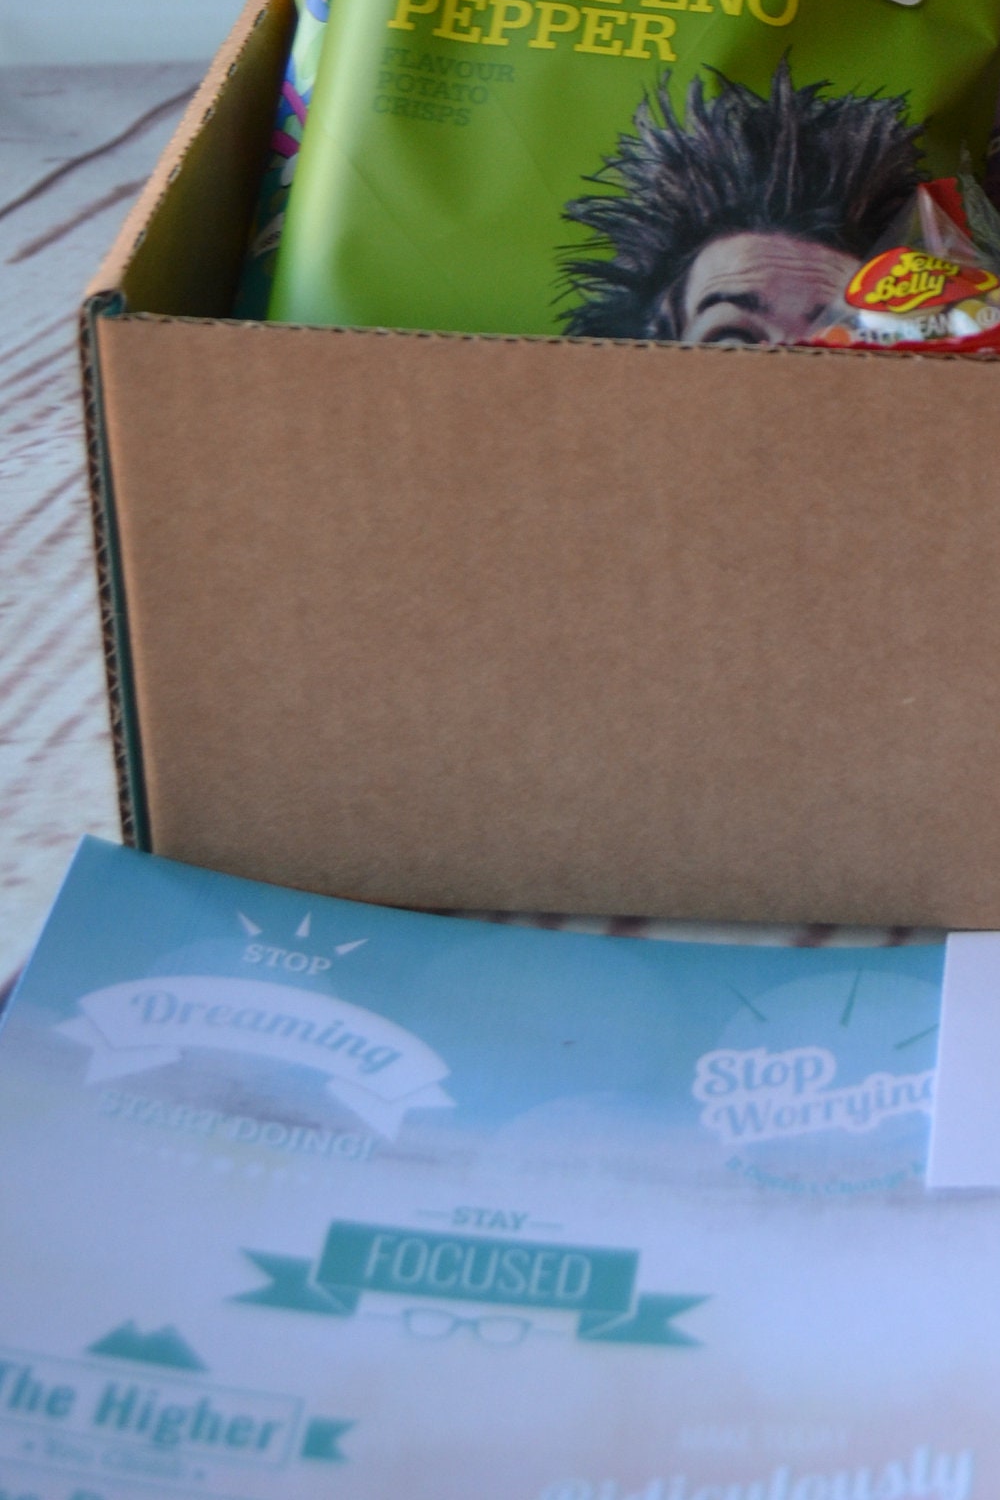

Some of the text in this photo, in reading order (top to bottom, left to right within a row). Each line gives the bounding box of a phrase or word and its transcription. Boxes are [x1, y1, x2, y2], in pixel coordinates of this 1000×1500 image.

[379, 46, 516, 84] FLAVOUR
[377, 71, 490, 106] POTATO
[373, 93, 473, 127] CRISPS
[890, 251, 961, 277] Jelly
[864, 269, 947, 314] Belly
[242, 941, 333, 976] STOP
[130, 987, 402, 1075] Dreaming
[702, 1053, 825, 1096] Stop
[451, 1205, 530, 1232] STAY
[363, 1232, 594, 1300] FOCUSED
[93, 1380, 284, 1450] Higher
